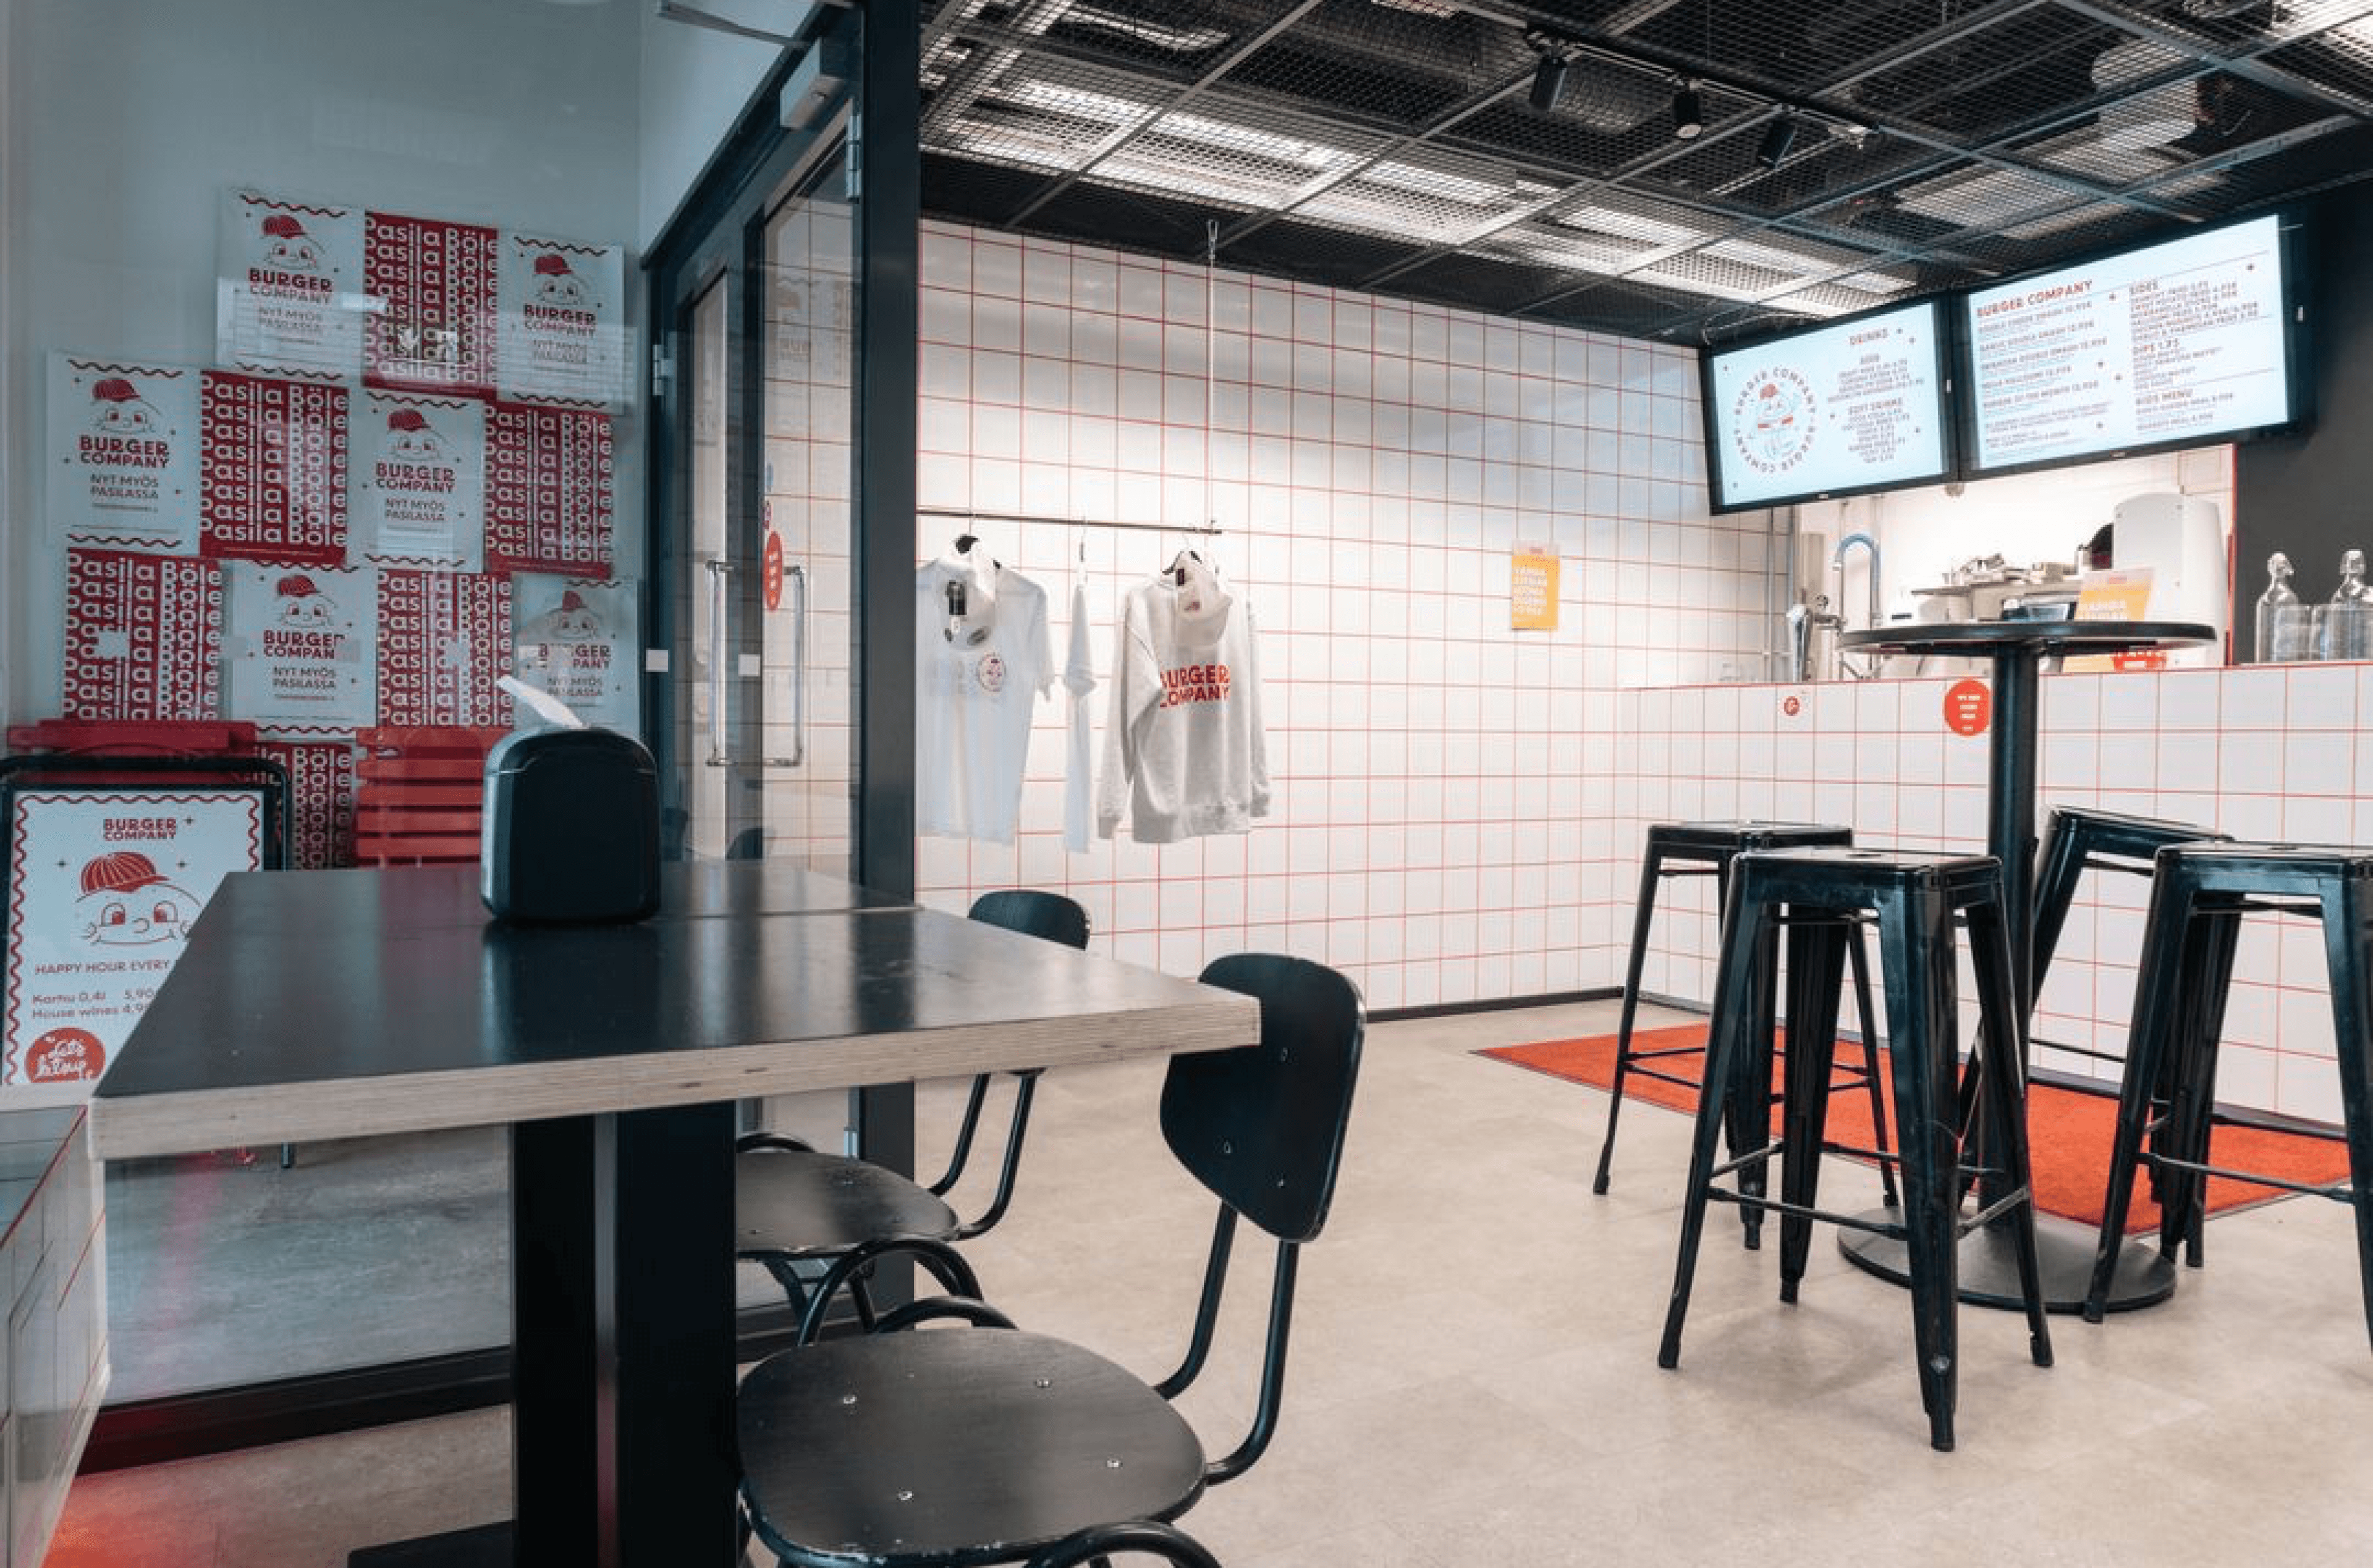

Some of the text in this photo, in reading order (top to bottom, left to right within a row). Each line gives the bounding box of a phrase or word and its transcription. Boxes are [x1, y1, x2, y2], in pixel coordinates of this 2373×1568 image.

[248, 268, 332, 292] BURGER
[1977, 280, 2092, 318] BURGER COMPANY
[523, 304, 596, 325] BURGER
[80, 435, 169, 456] BURGER
[80, 452, 169, 468] COMPANY
[376, 462, 455, 481] BURGER
[376, 479, 454, 493] COMPANY
[263, 645, 335, 660] COMPAN
[538, 643, 611, 658] BGER
[1160, 685, 1230, 708] OMPANY
[104, 818, 177, 831] BURGER
[104, 830, 177, 841] COMPANY
[35, 959, 170, 975] HAPPY HOUR EVERY
[32, 1009, 75, 1019] House
[78, 1007, 119, 1016] wines
